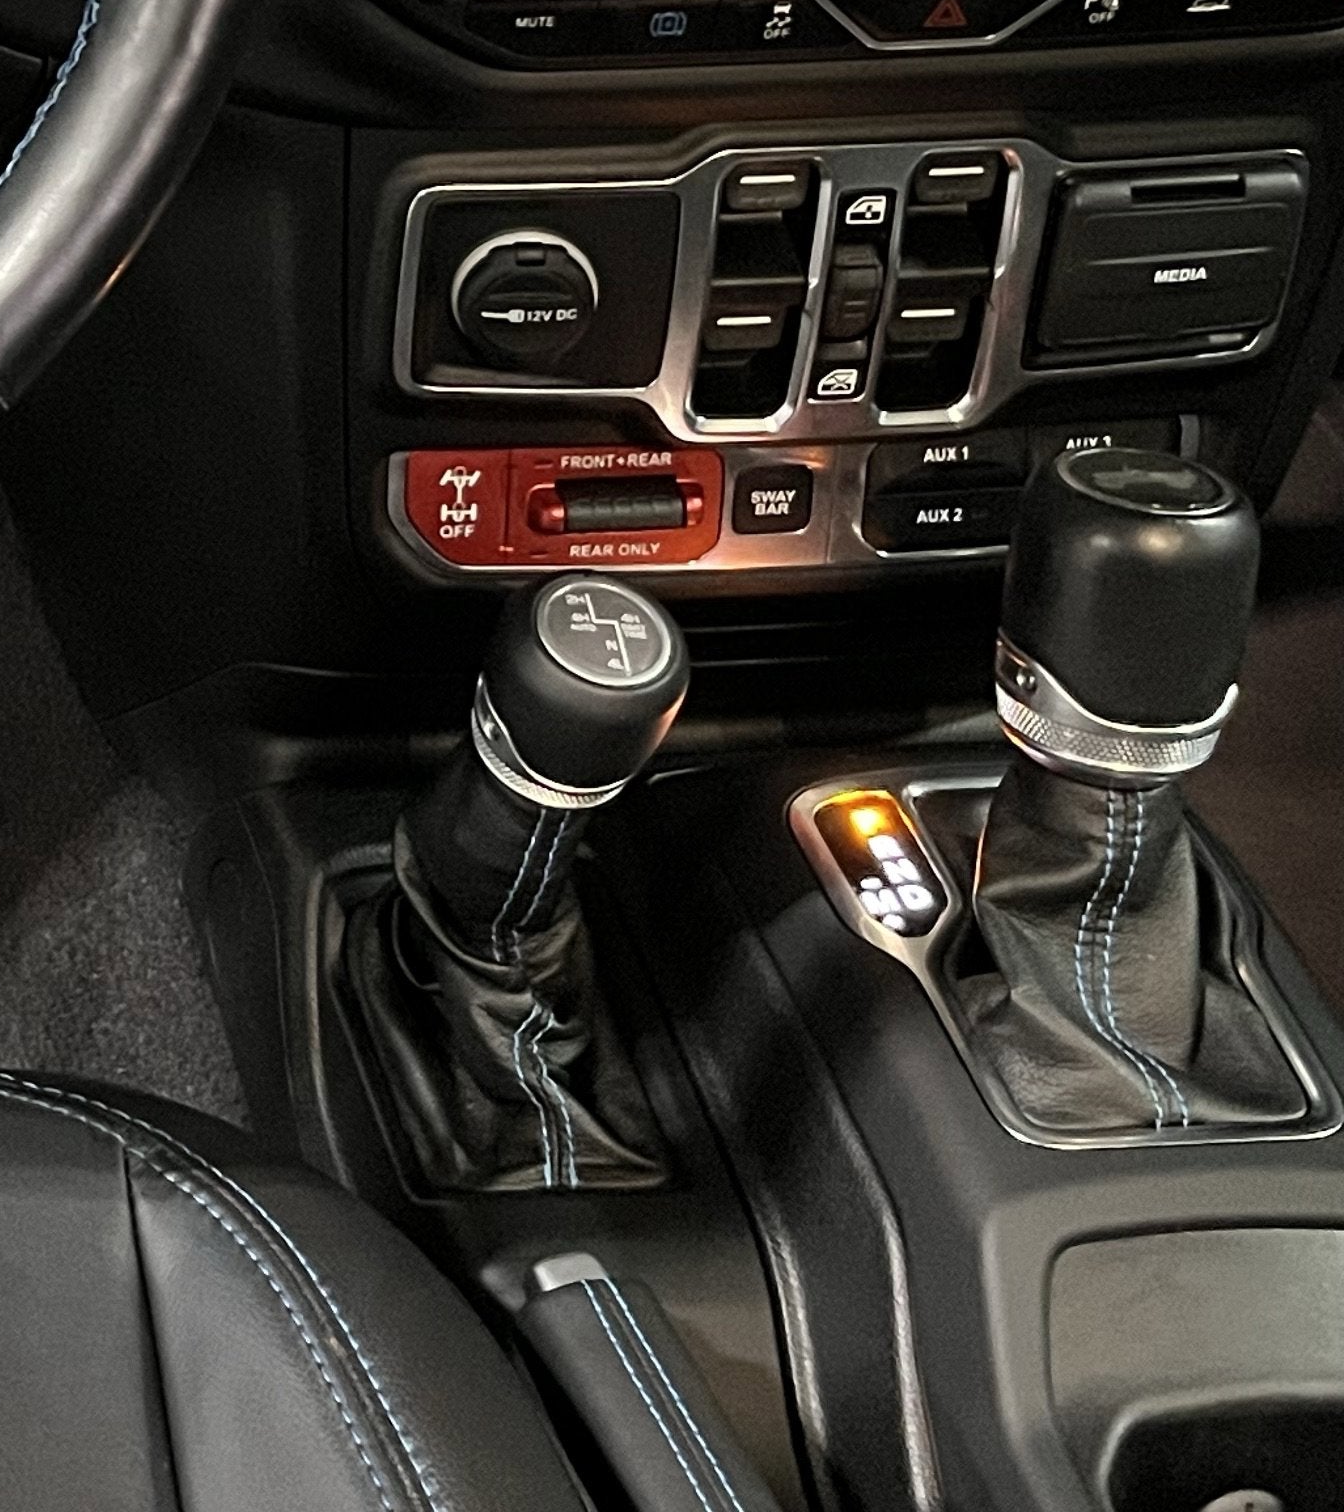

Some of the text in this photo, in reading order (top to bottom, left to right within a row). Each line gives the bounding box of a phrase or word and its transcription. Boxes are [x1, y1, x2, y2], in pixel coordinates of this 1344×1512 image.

[515, 15, 555, 30] MUTE
[1088, 10, 1115, 24] OFF
[763, 28, 791, 40] OFF
[1154, 266, 1208, 284] MEDIA
[527, 308, 578, 322] 12V DC
[923, 446, 970, 462] AUX 1
[750, 489, 797, 505] SWAY
[754, 501, 790, 516] BAR
[916, 508, 964, 524] AUX 2
[439, 524, 475, 539] OFF
[568, 542, 661, 558] REAR ONLY
